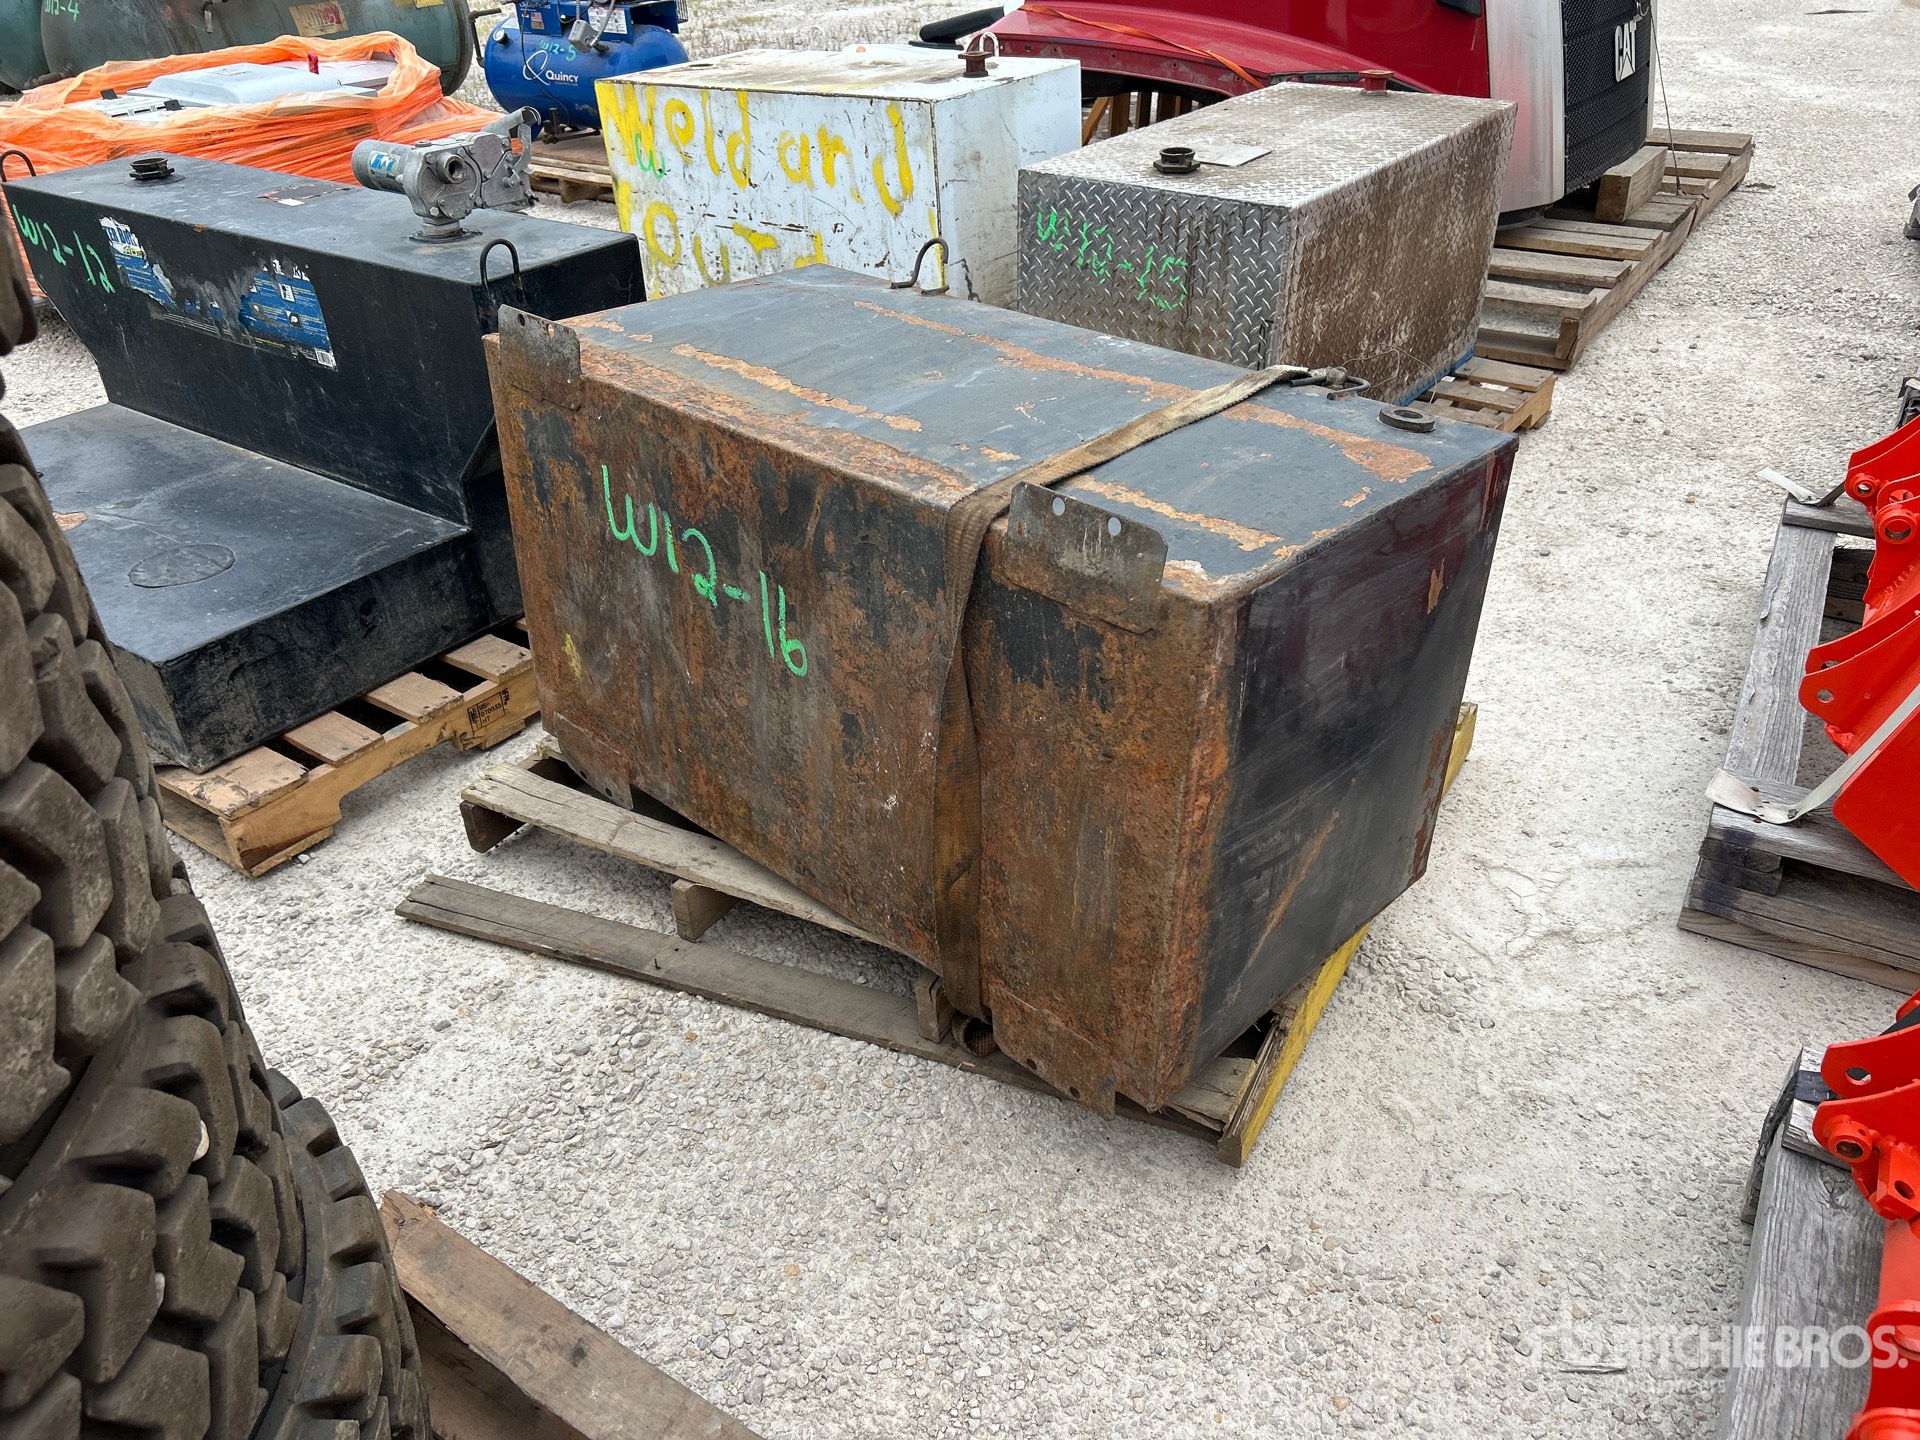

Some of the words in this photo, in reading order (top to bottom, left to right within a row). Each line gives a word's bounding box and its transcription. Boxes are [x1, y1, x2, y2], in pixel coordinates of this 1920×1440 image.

[545, 69, 579, 83] Quincy
[1614, 20, 1637, 83] CAT
[594, 82, 750, 190] Weld
[776, 100, 915, 218] and
[12, 203, 116, 293] W12-12
[601, 464, 809, 678] W12-16
